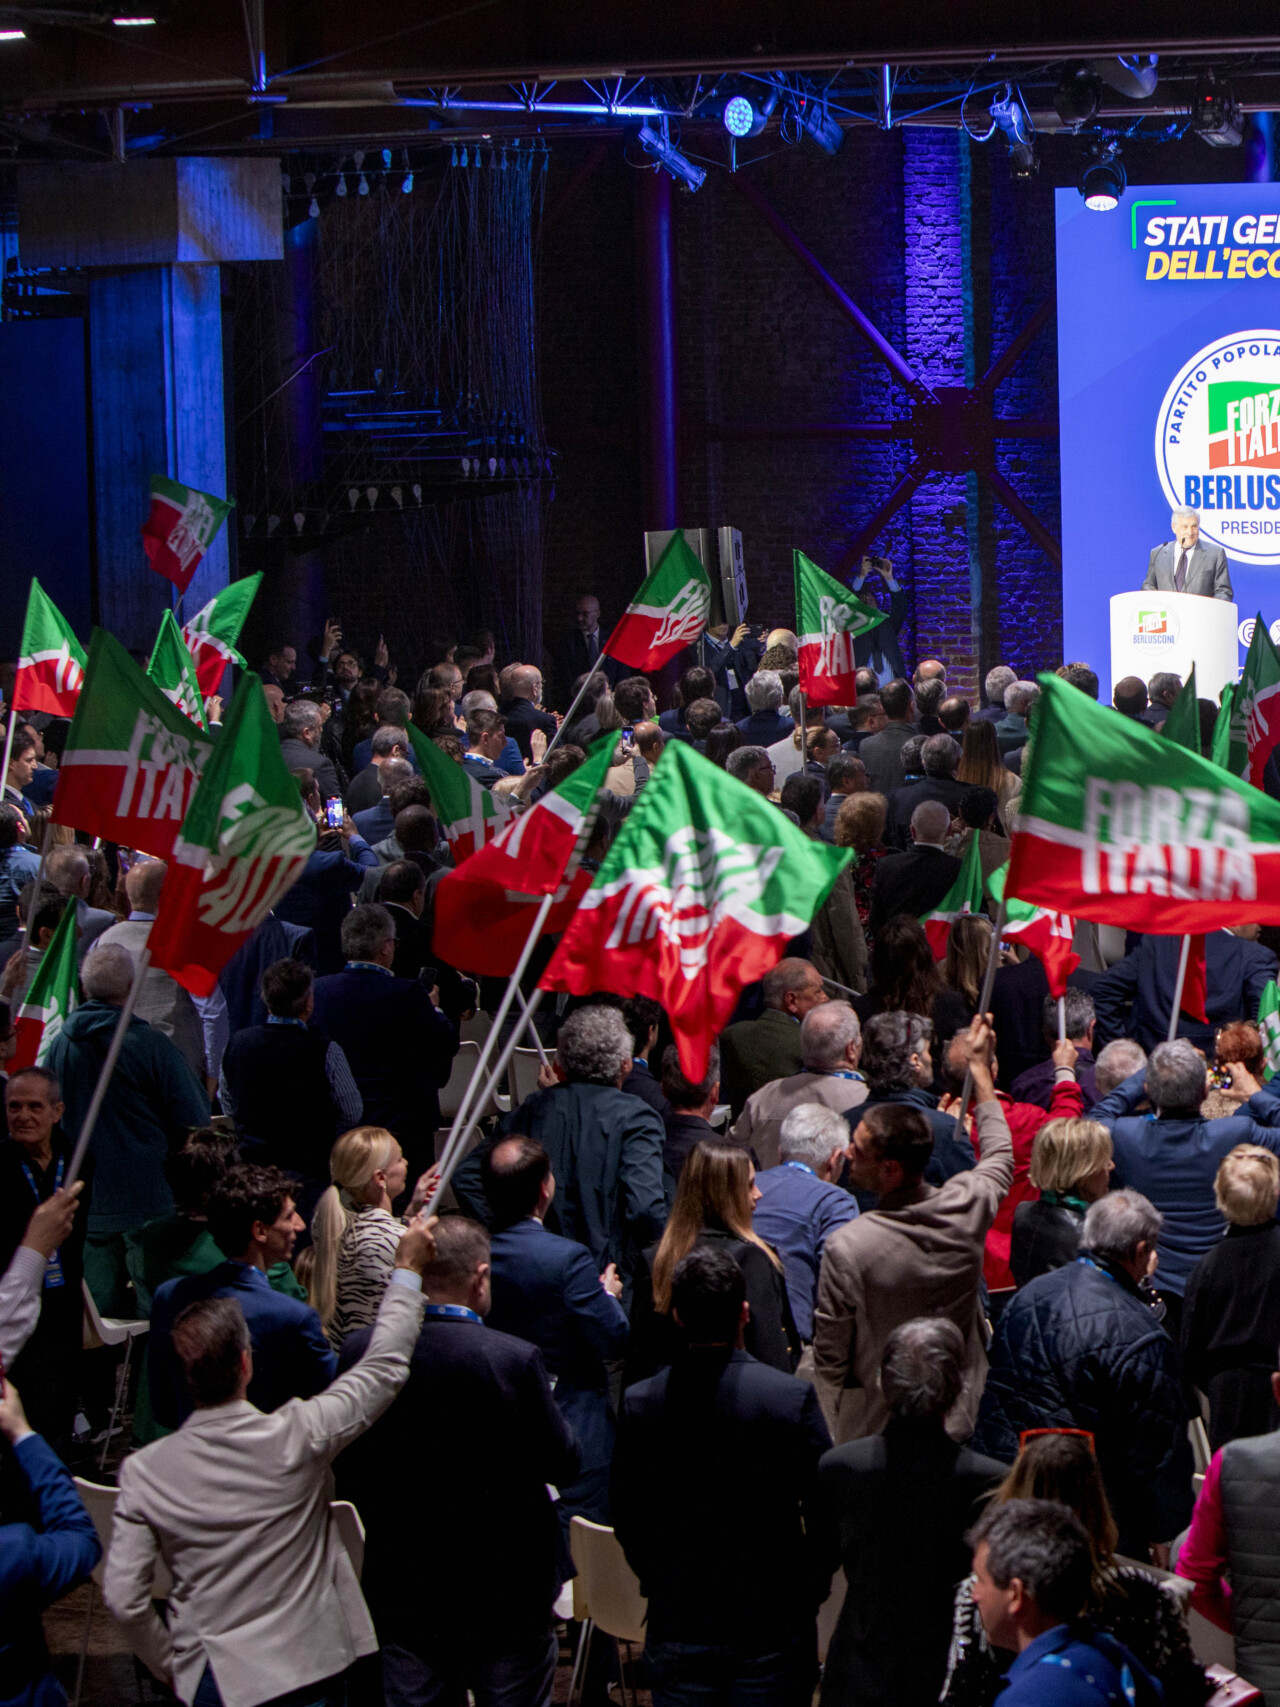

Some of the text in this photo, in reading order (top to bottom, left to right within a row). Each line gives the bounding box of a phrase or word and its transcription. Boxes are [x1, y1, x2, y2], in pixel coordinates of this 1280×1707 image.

[1144, 215, 1228, 246] STATI
[1169, 370, 1208, 445] PARTITO
[1132, 634, 1175, 645] BERLUSCONI
[1084, 775, 1251, 849] FORZA
[1081, 841, 1258, 901] ITALIA
